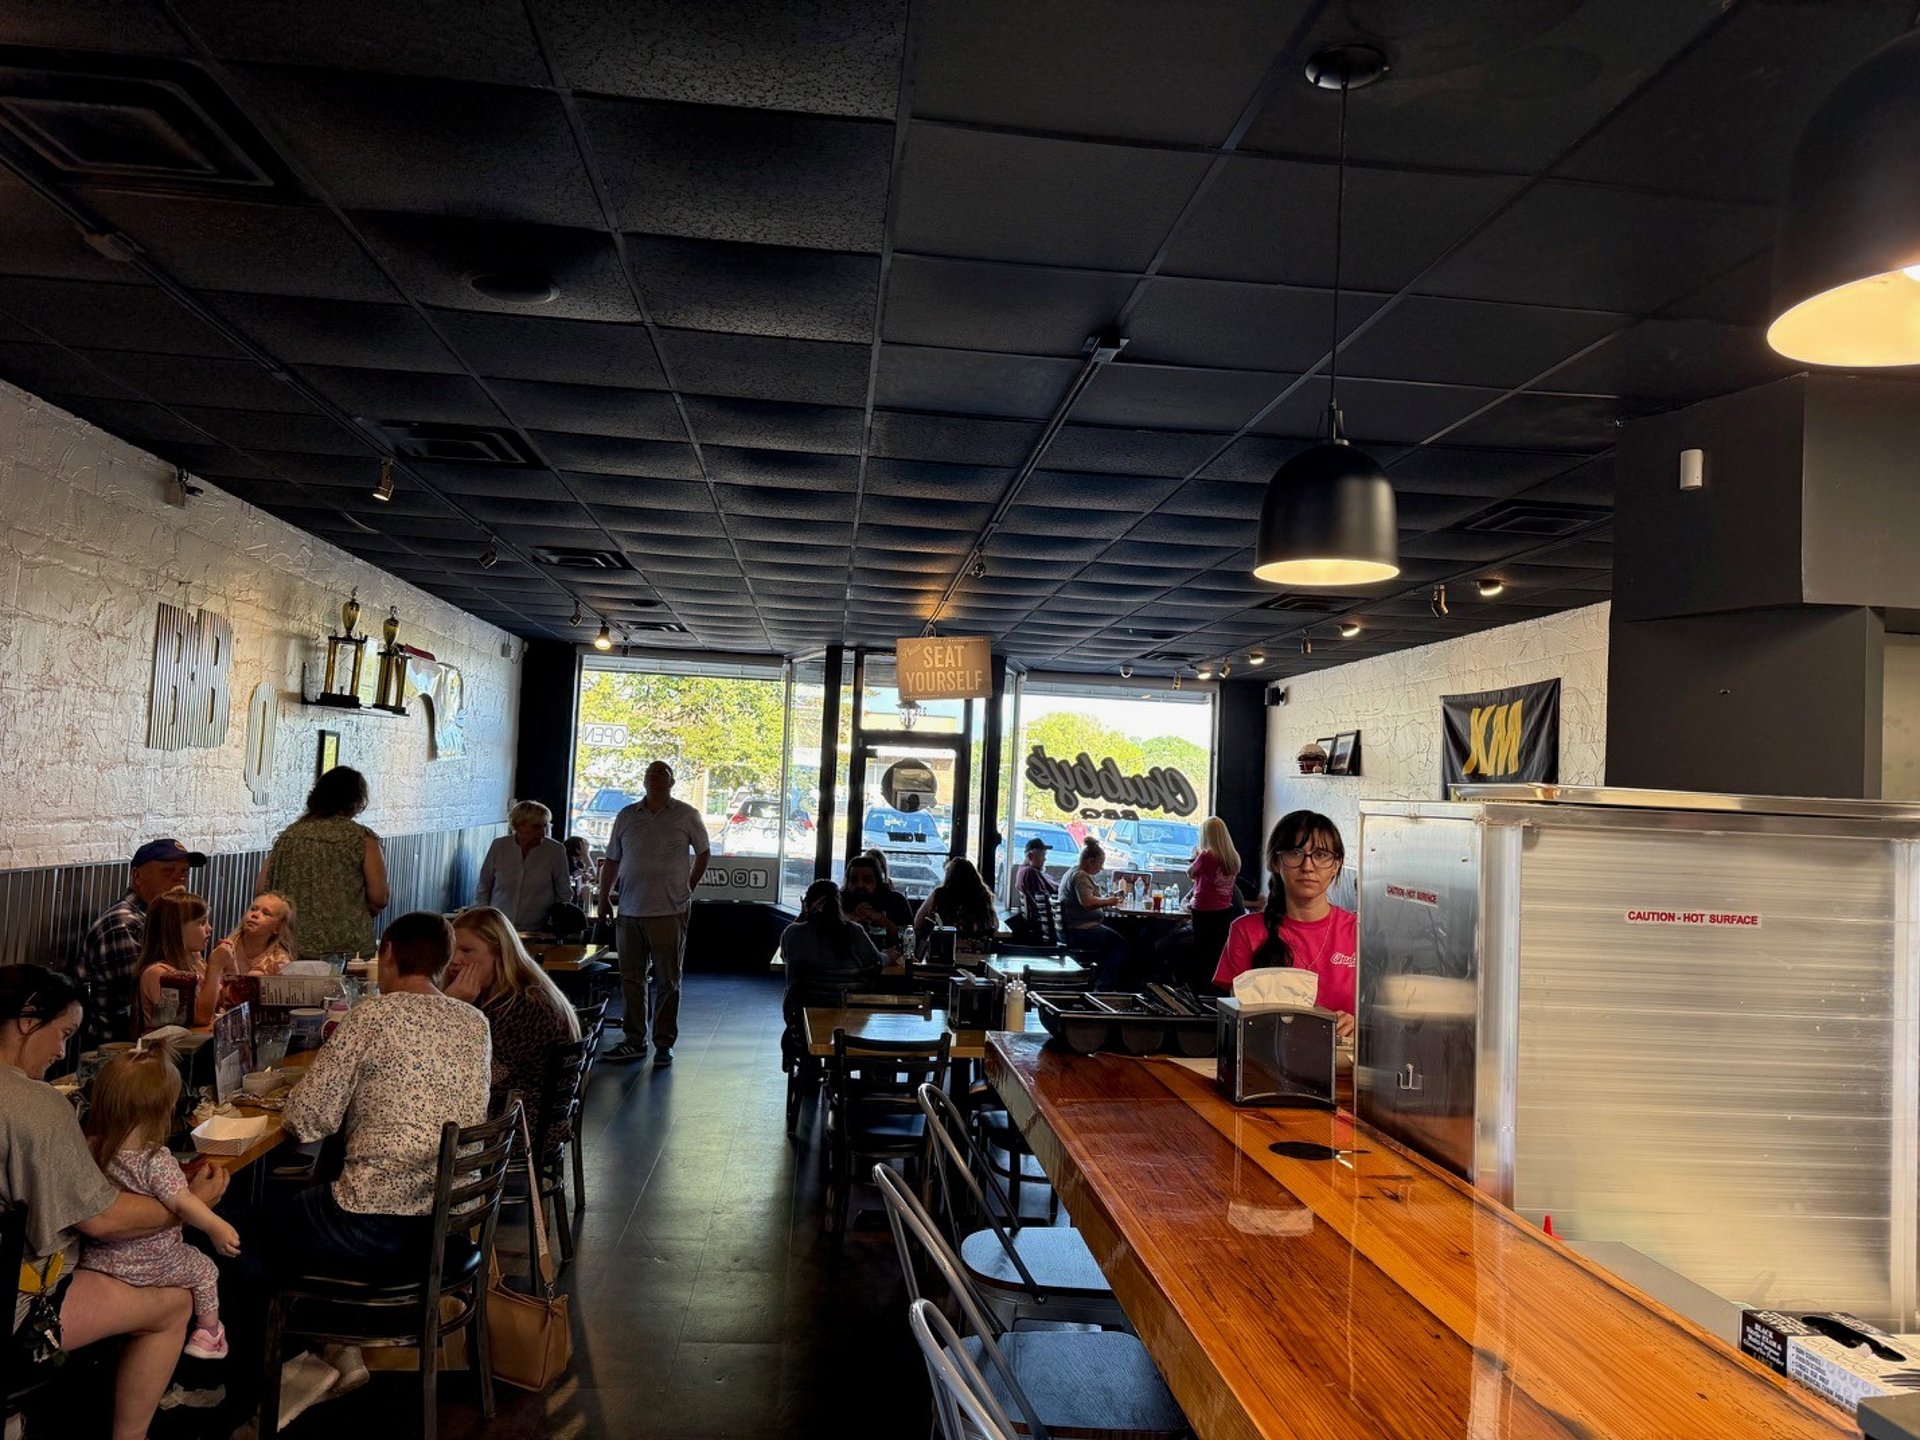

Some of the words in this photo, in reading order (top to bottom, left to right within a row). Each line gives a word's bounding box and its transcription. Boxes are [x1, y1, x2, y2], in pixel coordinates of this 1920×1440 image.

[923, 645, 965, 669] SEAT
[905, 669, 983, 693] YOURSELF
[1628, 911, 1675, 923] CAUTION
[1683, 912, 1705, 924] HOT
[1709, 914, 1758, 926] SURFACE
[1754, 1322, 1773, 1339] BLACK
